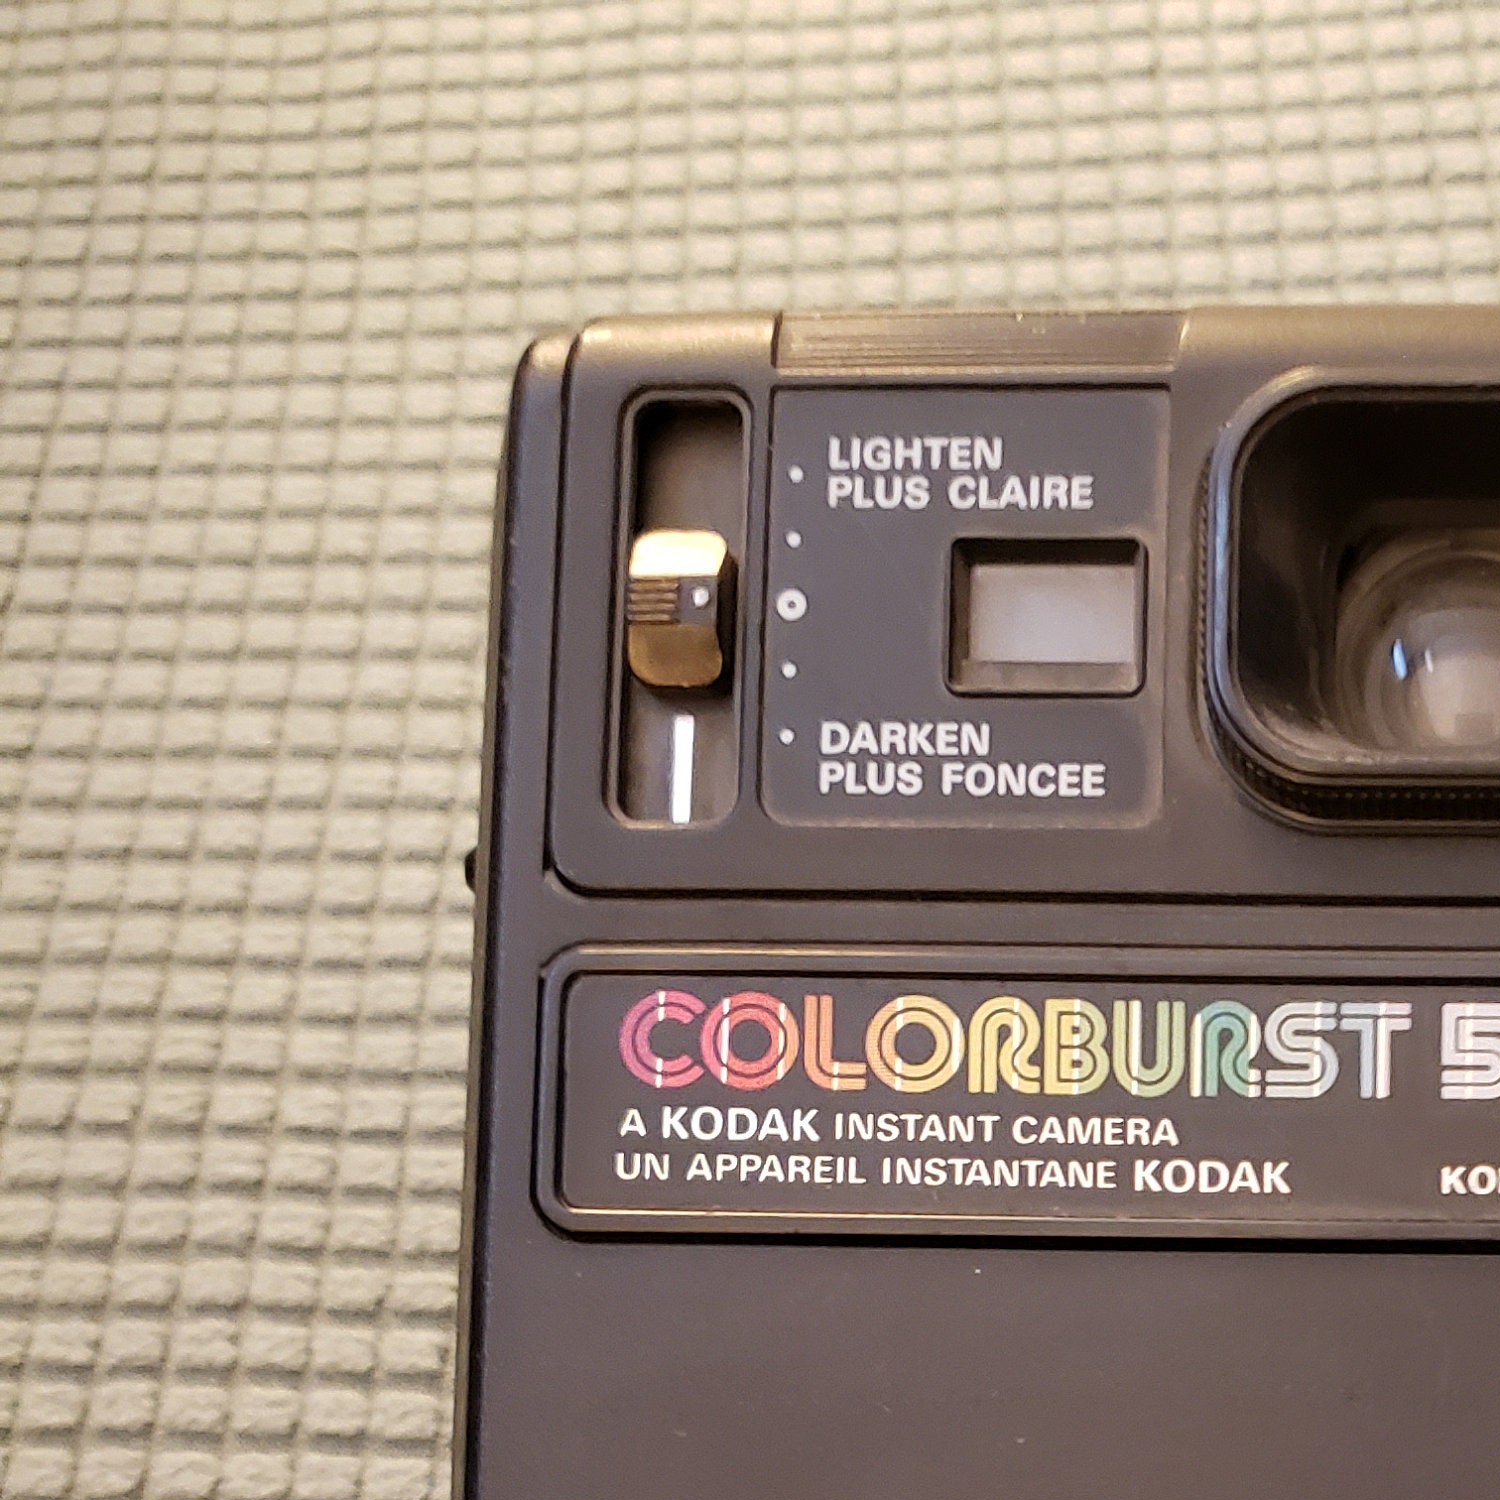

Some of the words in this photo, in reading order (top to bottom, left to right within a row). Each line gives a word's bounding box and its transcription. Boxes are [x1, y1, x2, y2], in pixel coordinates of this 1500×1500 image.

[827, 436, 1003, 471] LIGHTEN
[827, 475, 931, 509] PLUS
[948, 475, 1095, 510] CLAIRE
[819, 721, 990, 756] DARKEN
[818, 761, 924, 796] PLUS
[941, 762, 1107, 798] FONCEE
[617, 989, 1413, 1100] COLORBURST
[618, 1108, 647, 1137] A
[661, 1106, 820, 1142] KODAK
[834, 1112, 1001, 1143] INSTANT
[1011, 1115, 1180, 1147] CAMERA
[616, 1153, 671, 1181] UN
[686, 1154, 867, 1185] APPAREIL
[882, 1157, 1117, 1189] INSTANTANE
[1133, 1158, 1293, 1195] KODAK
